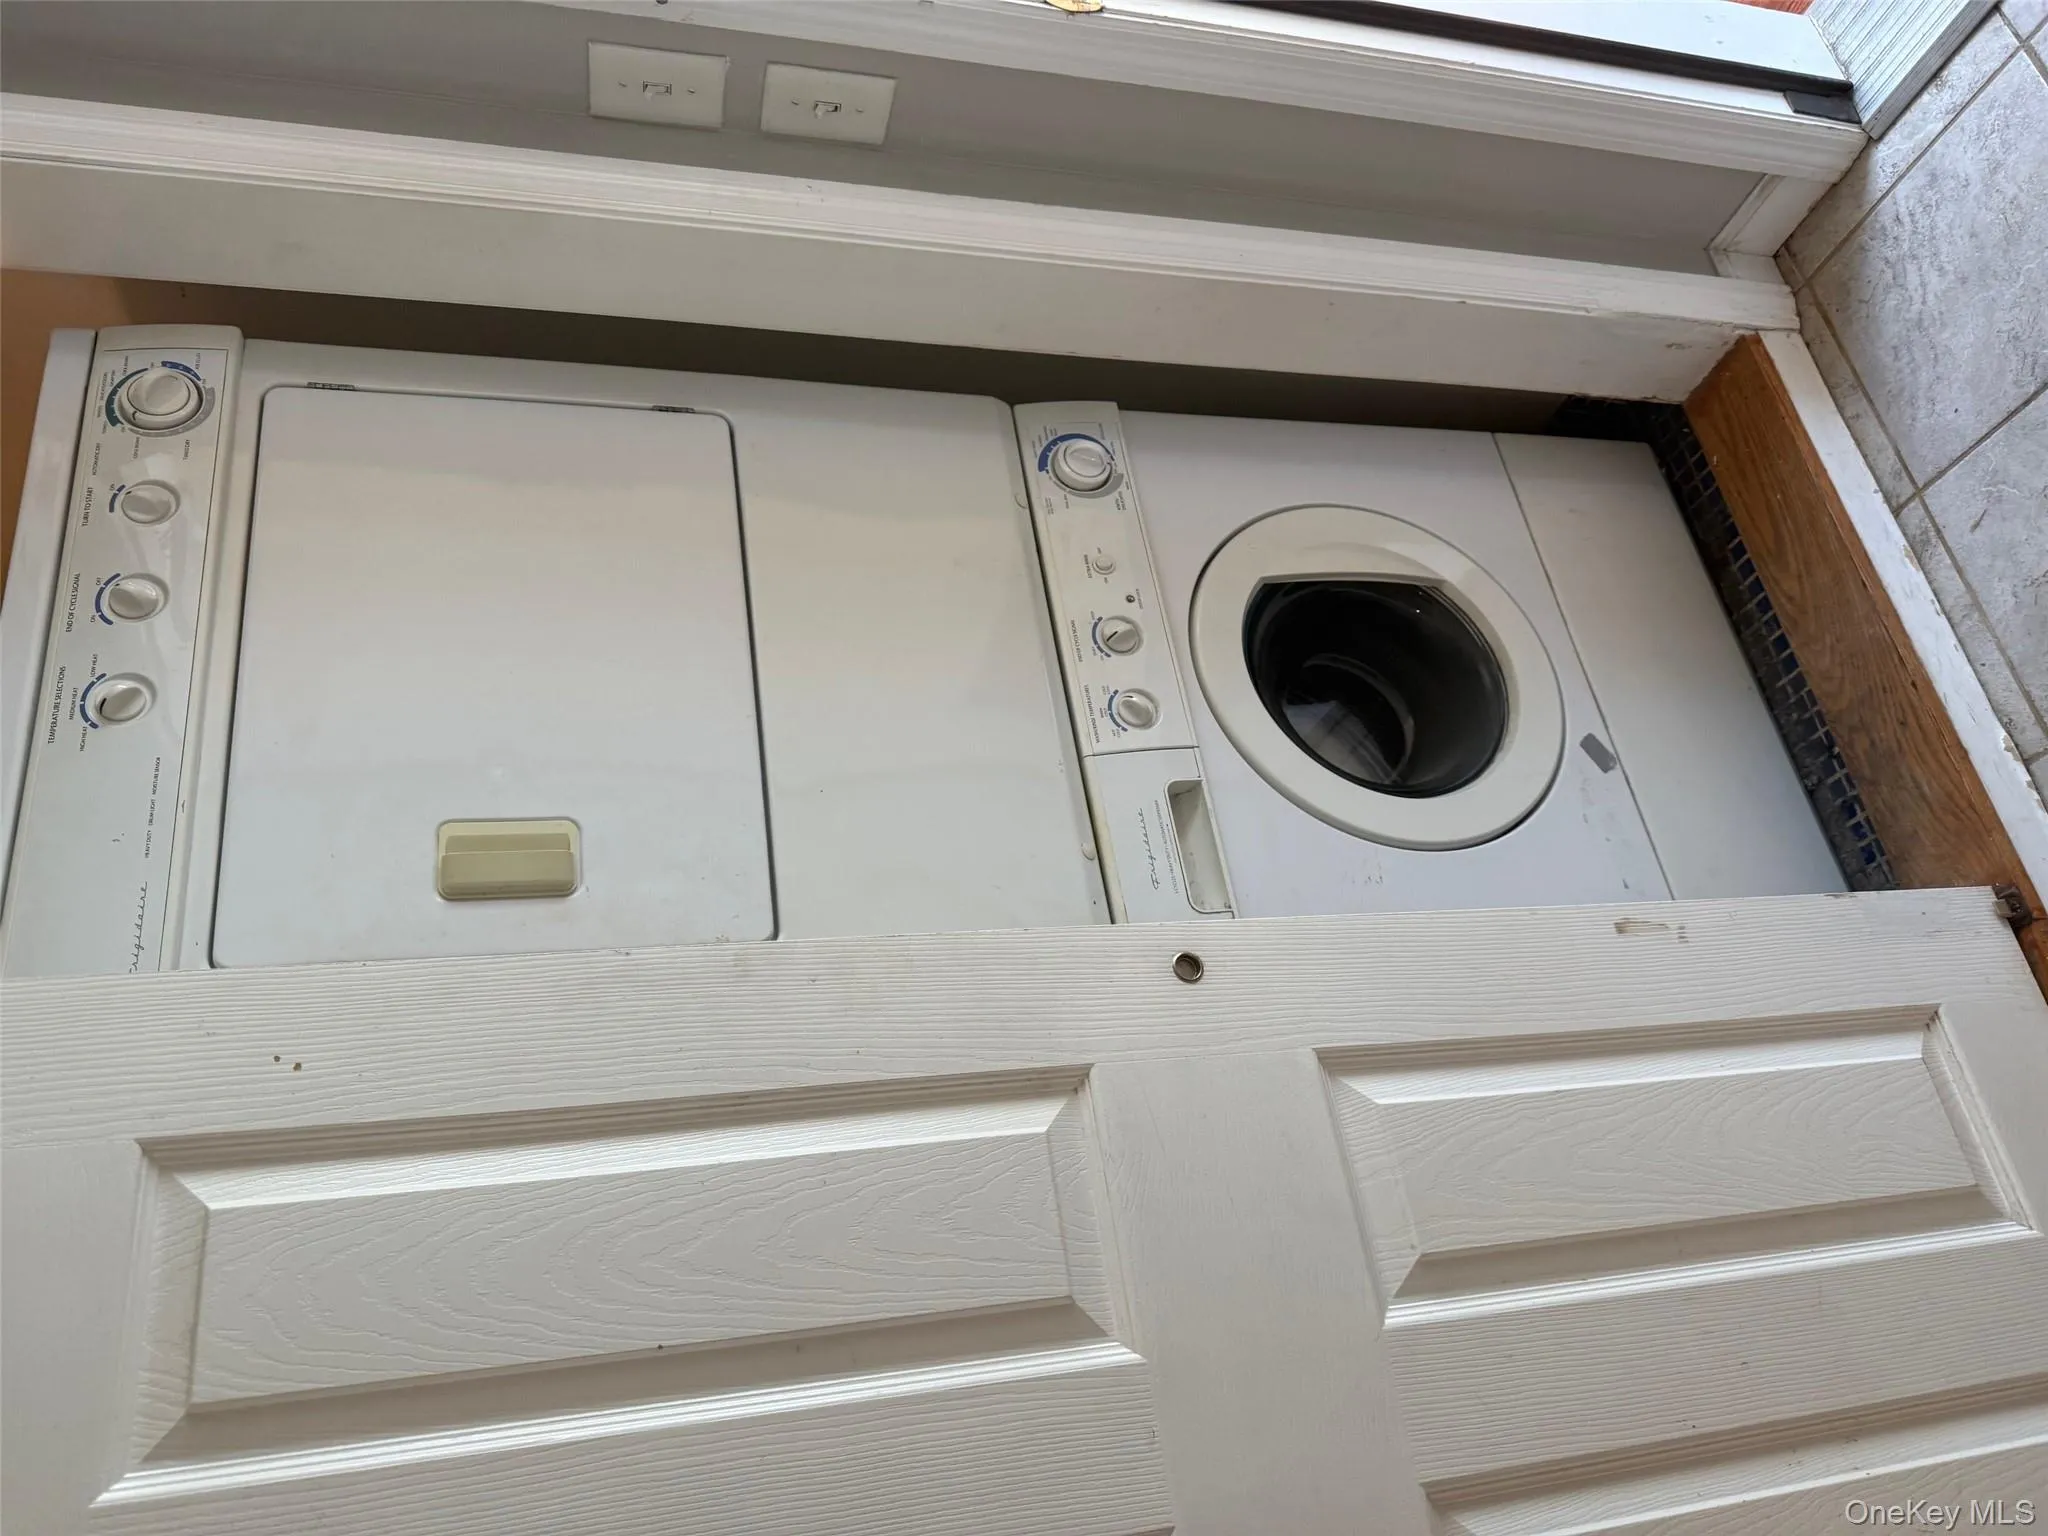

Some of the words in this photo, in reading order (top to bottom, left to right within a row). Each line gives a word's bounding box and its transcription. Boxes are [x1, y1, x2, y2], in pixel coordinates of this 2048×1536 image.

[85, 487, 94, 502] START
[83, 503, 92, 511] TO
[82, 512, 90, 527] TURN
[72, 573, 80, 593] SIGNAL
[69, 594, 78, 611] CYCLE
[68, 612, 75, 620] OF
[47, 701, 60, 744] TEMPERATURE
[55, 665, 66, 701] SELECTIONS
[144, 843, 152, 858] HEAVY
[1137, 807, 1160, 890] Frigidaire
